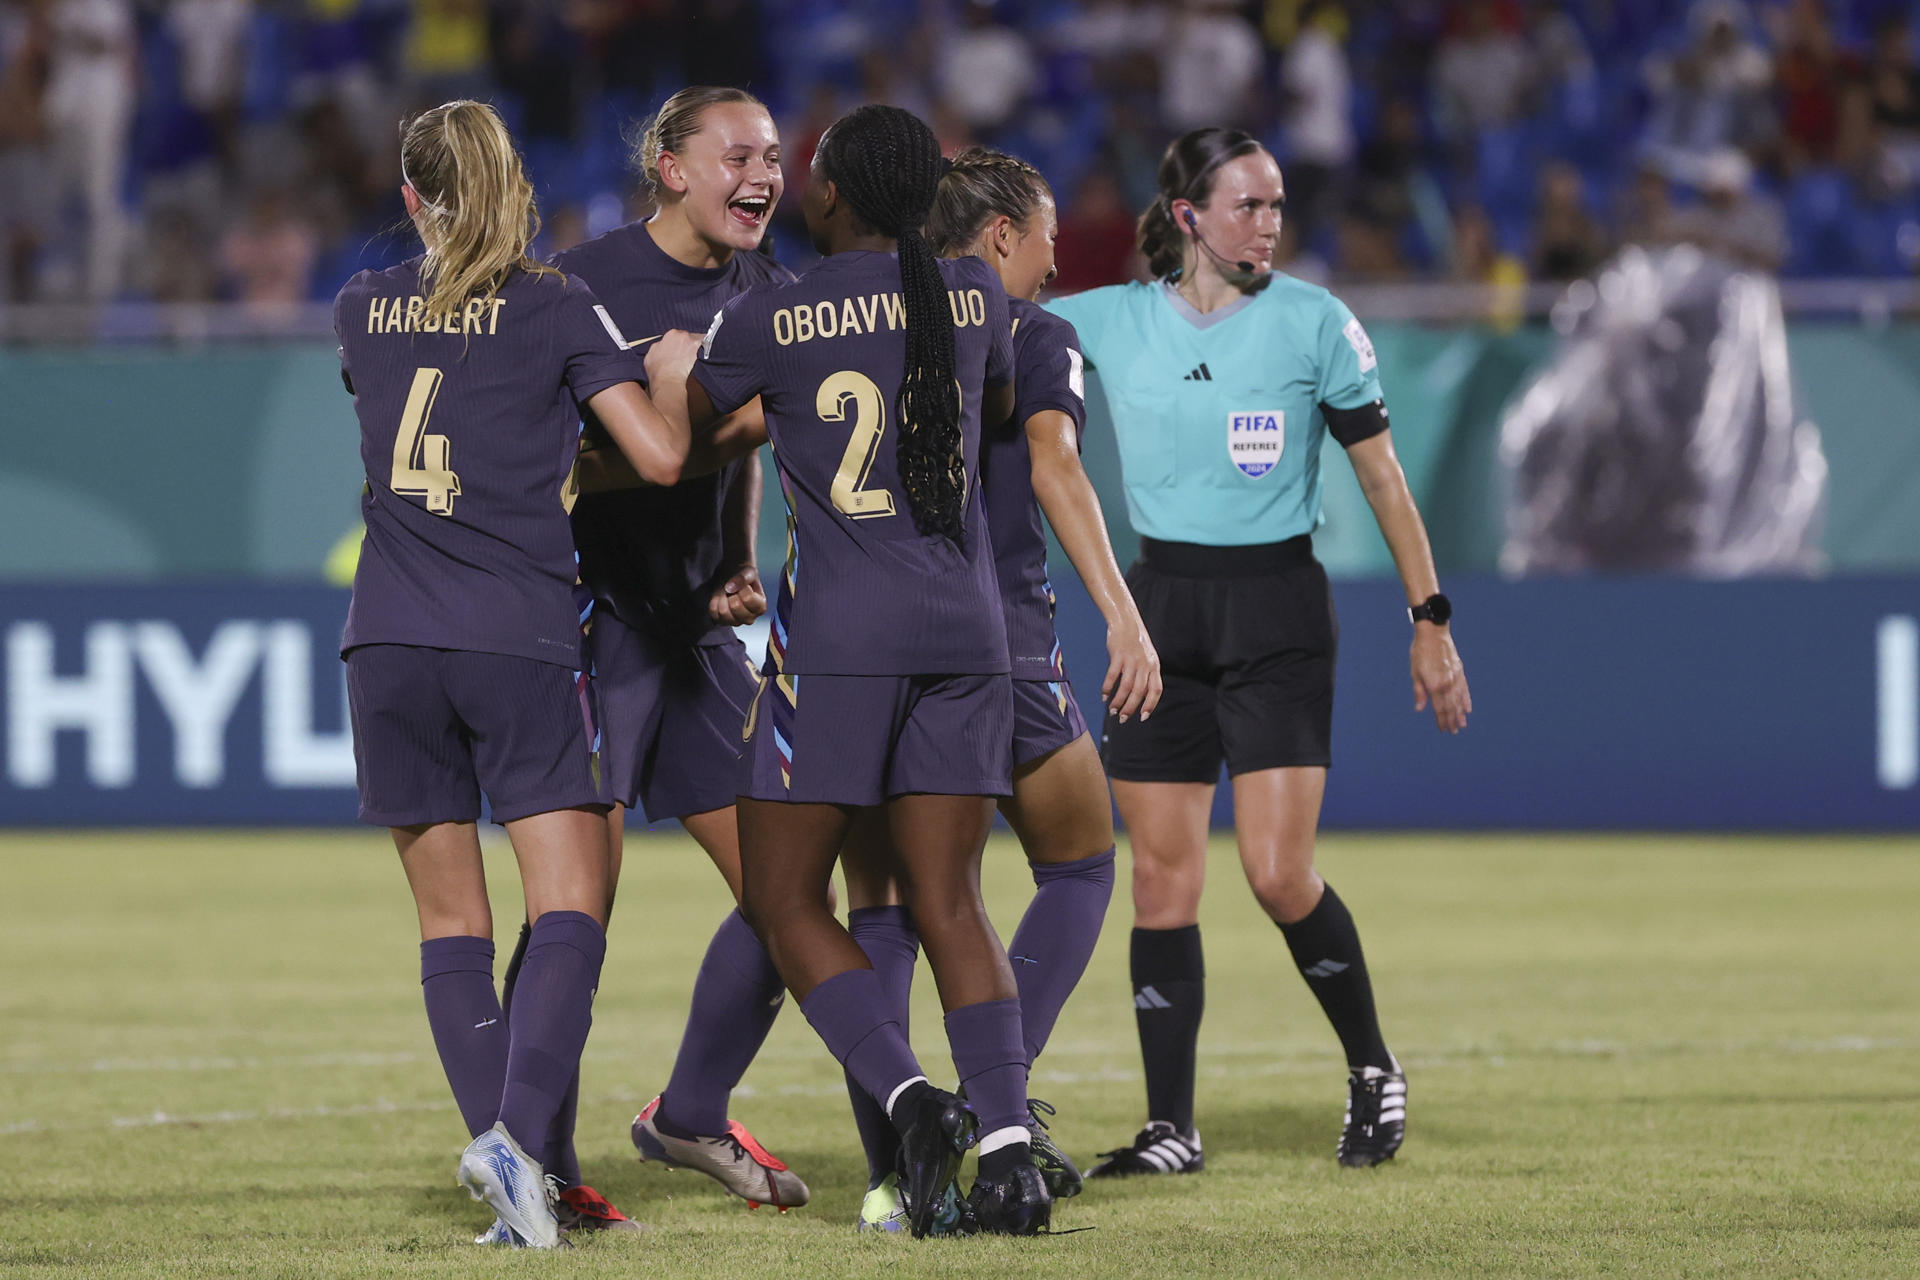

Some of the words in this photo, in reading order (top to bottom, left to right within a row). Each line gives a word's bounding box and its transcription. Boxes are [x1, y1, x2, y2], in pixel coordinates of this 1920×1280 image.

[367, 295, 506, 336] HARBERT
[773, 288, 986, 347] OBOAVWUO
[390, 367, 462, 517] 4
[1233, 415, 1278, 432] FIFA
[1233, 442, 1279, 452] REFEREE
